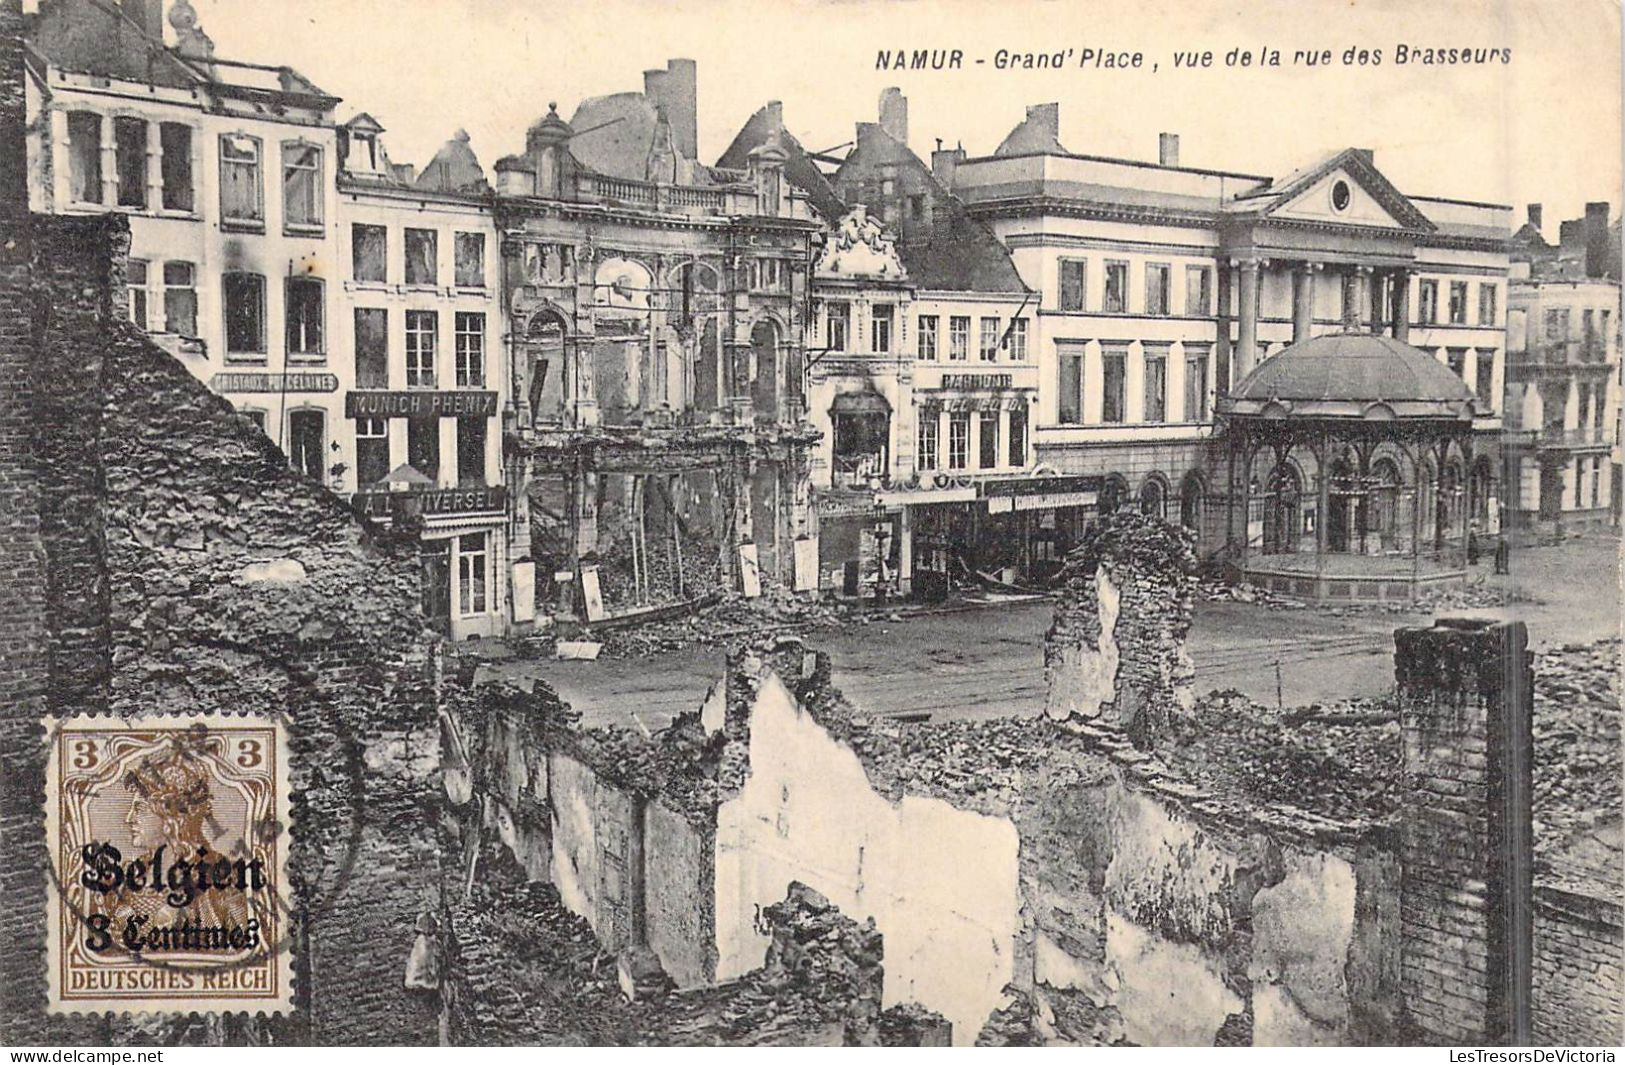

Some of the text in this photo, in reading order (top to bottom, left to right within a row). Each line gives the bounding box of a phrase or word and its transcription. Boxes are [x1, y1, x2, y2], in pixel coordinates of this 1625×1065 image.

[354, 395, 421, 414] MUNICH
[73, 739, 263, 769] 3 3
[82, 842, 267, 908] Belgien
[85, 914, 260, 951] 3 Centimes
[71, 969, 268, 990] DEUTSCHES REICH
